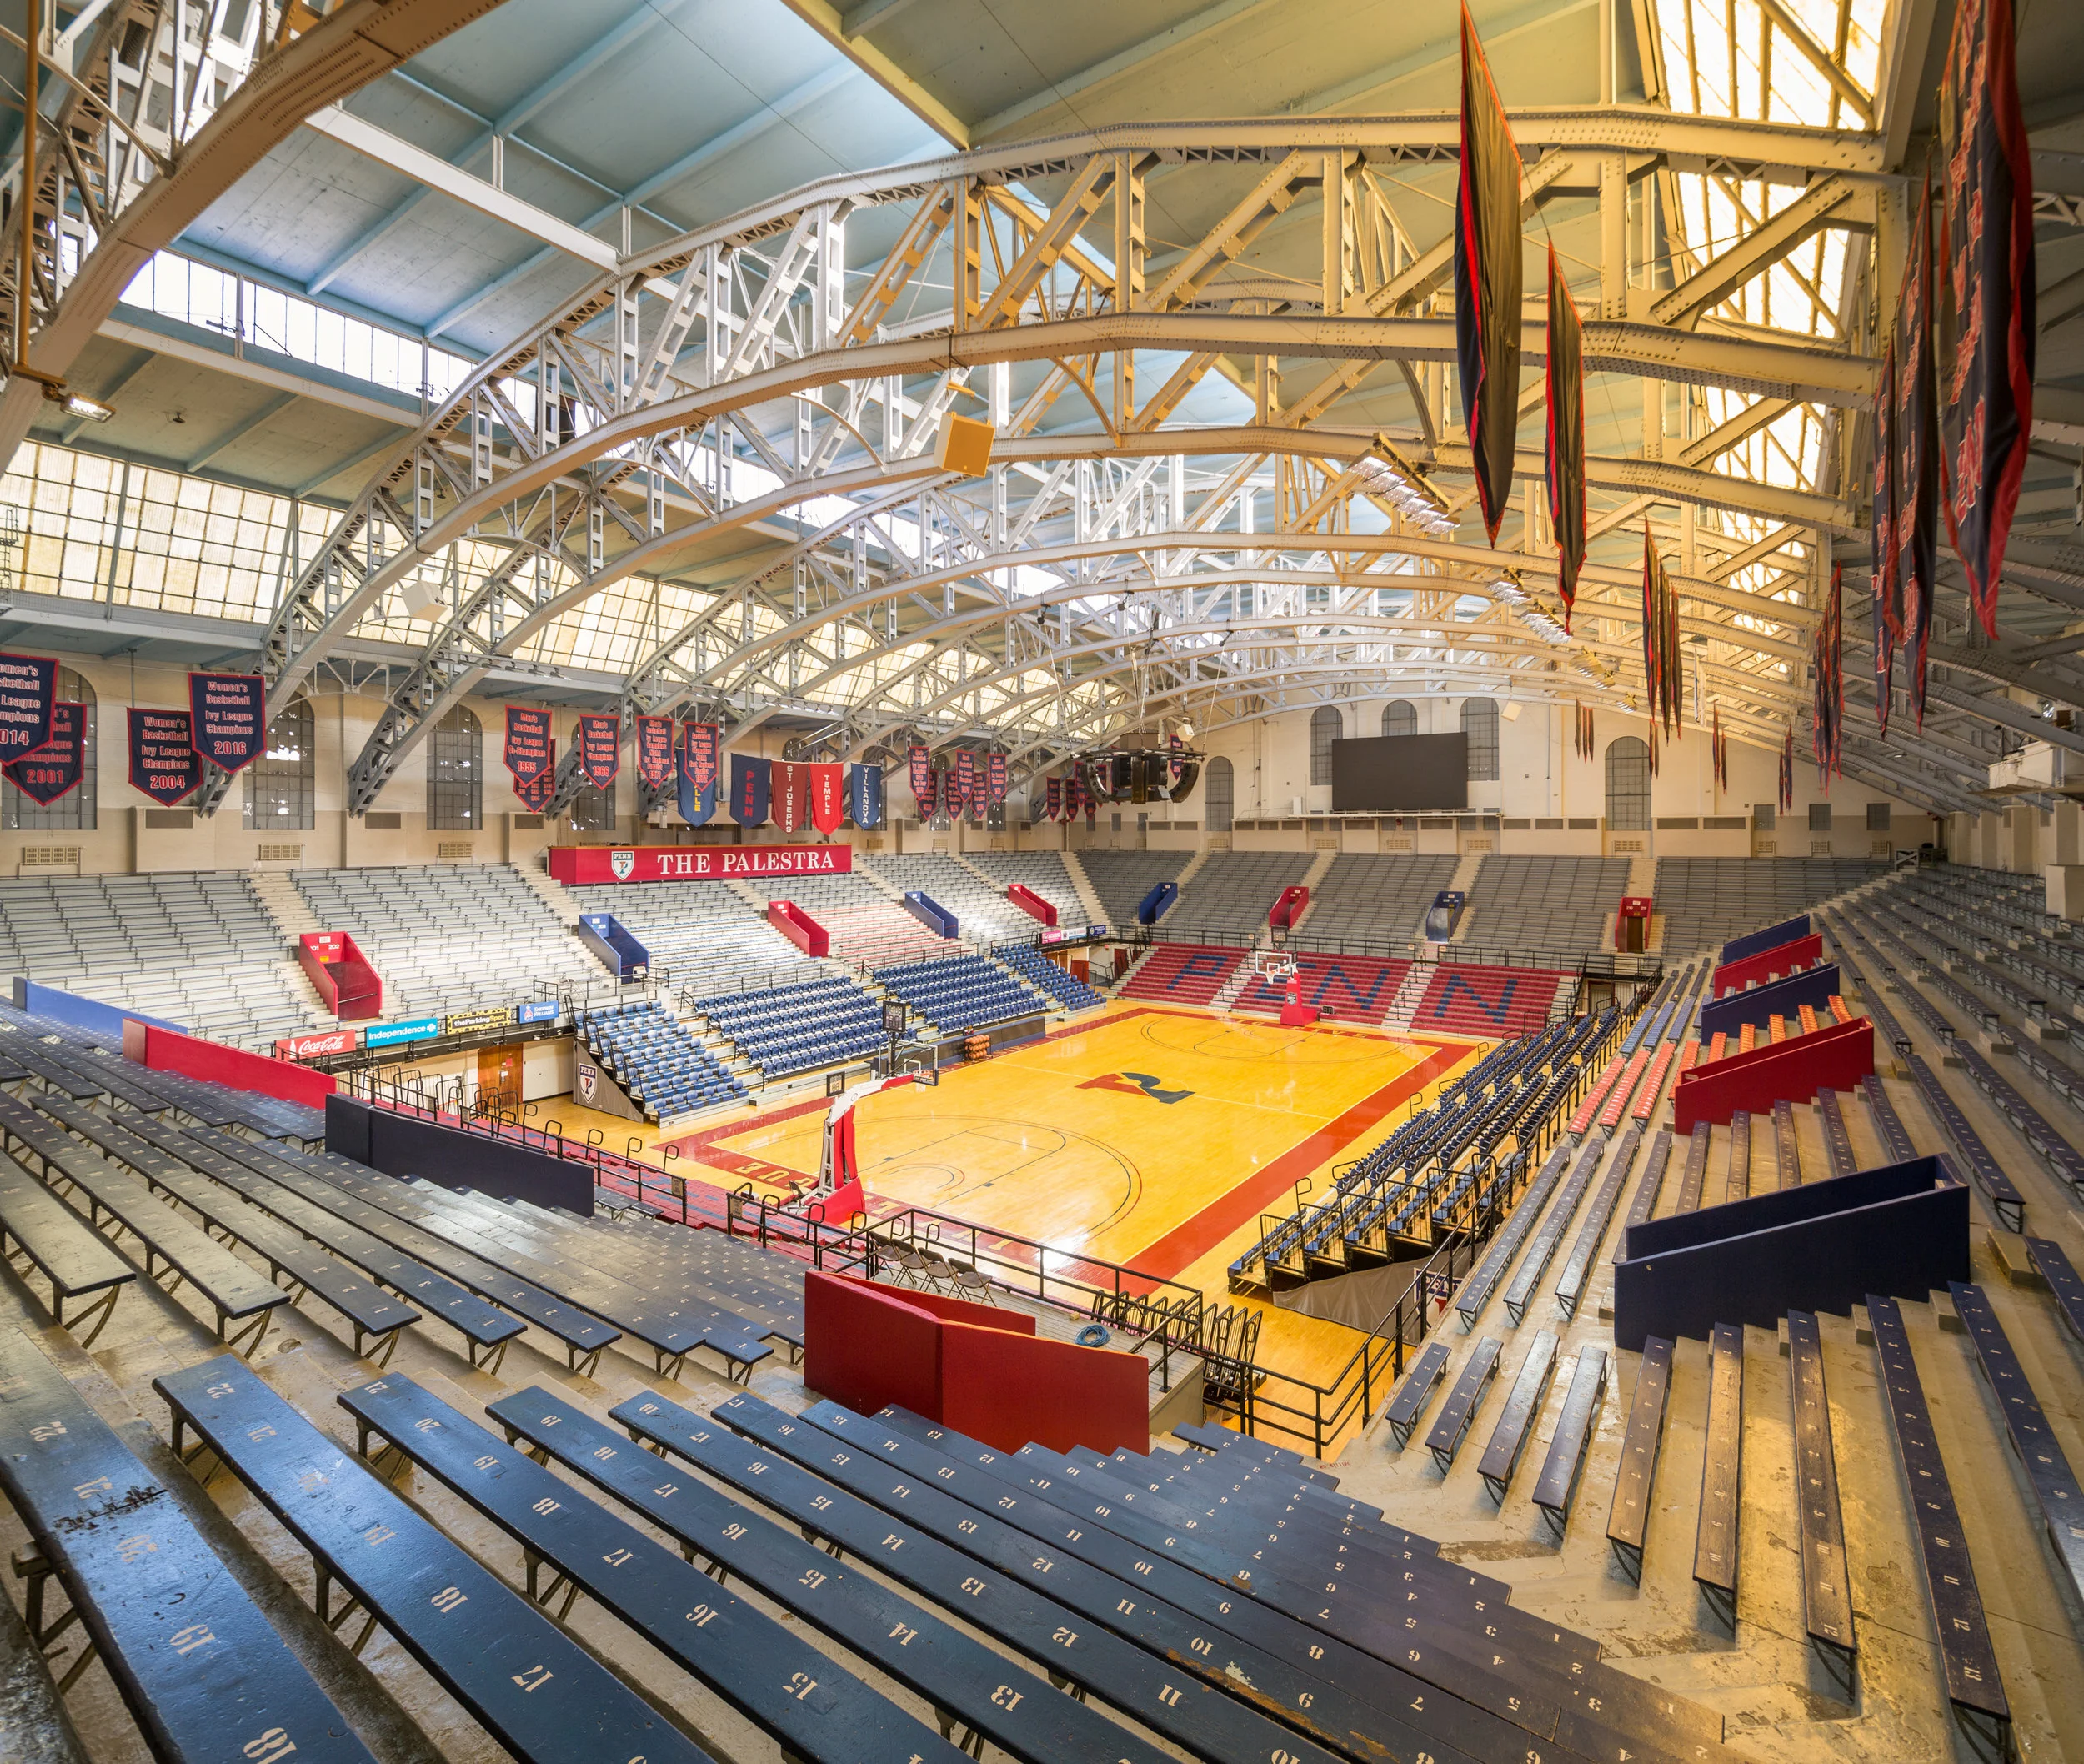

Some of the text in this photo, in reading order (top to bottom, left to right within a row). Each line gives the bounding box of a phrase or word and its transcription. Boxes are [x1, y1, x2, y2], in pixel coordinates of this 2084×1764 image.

[207, 681, 248, 693] Women's
[206, 694, 250, 705] Basketball
[144, 716, 186, 729] Women's
[205, 710, 253, 722] Ivy League
[142, 730, 188, 741] Basketball
[206, 724, 253, 735] Champions
[514, 723, 543, 734] Basketball
[588, 730, 614, 739] Basketball
[214, 741, 247, 754] 2016
[524, 737, 543, 746] League
[141, 745, 191, 758] Ivy League
[143, 759, 190, 770] Champions
[518, 761, 537, 773] 1955
[592, 765, 609, 776] 1966
[27, 769, 63, 784] 2001
[150, 775, 185, 789] 2004
[744, 770, 754, 817] PENN
[823, 774, 831, 814] TEMPLE
[785, 786, 794, 833] JOSEPHS
[657, 851, 835, 874] THE PALESTRA
[454, 1015, 505, 1026] theParkingSpot
[368, 1025, 426, 1040] Independence
[298, 1035, 346, 1054] Coca-Cola
[581, 1066, 595, 1075] PENN
[207, 1383, 235, 1398] 22
[365, 1381, 388, 1394] 21
[414, 1418, 440, 1433] 20
[541, 1416, 562, 1426] 19
[30, 1421, 68, 1441] 22
[689, 1432, 710, 1442] 17
[594, 1447, 617, 1460] 18
[938, 1468, 954, 1478] 13
[1067, 1467, 1080, 1476] 10
[653, 1484, 679, 1497] 17
[533, 1498, 561, 1515] 18
[810, 1496, 833, 1510] 15
[999, 1497, 1016, 1509] 12
[1095, 1506, 1111, 1516] 10
[723, 1524, 748, 1540] 16
[959, 1521, 979, 1533] 13
[882, 1534, 904, 1550] 14
[602, 1549, 633, 1566] 17
[1033, 1558, 1054, 1572] 12
[1135, 1561, 1153, 1575] 10
[799, 1570, 826, 1589] 15
[961, 1578, 986, 1595] 13
[431, 1587, 468, 1612] 18
[1117, 1599, 1135, 1615] 11
[686, 1605, 718, 1626] 16
[1405, 1618, 1416, 1628] 5
[889, 1622, 918, 1645] 14
[1053, 1627, 1079, 1647] 12
[1486, 1626, 1496, 1636] 3
[1555, 1634, 1560, 1642] 1
[169, 1625, 217, 1655] 19
[1191, 1638, 1213, 1655] 10
[1310, 1646, 1324, 1659] 8
[512, 1666, 554, 1692] 17
[783, 1673, 818, 1700] 15
[991, 1686, 1023, 1711] 13
[1159, 1684, 1182, 1706] 11
[1410, 1697, 1423, 1711] 7
[243, 1728, 296, 1764] 18
